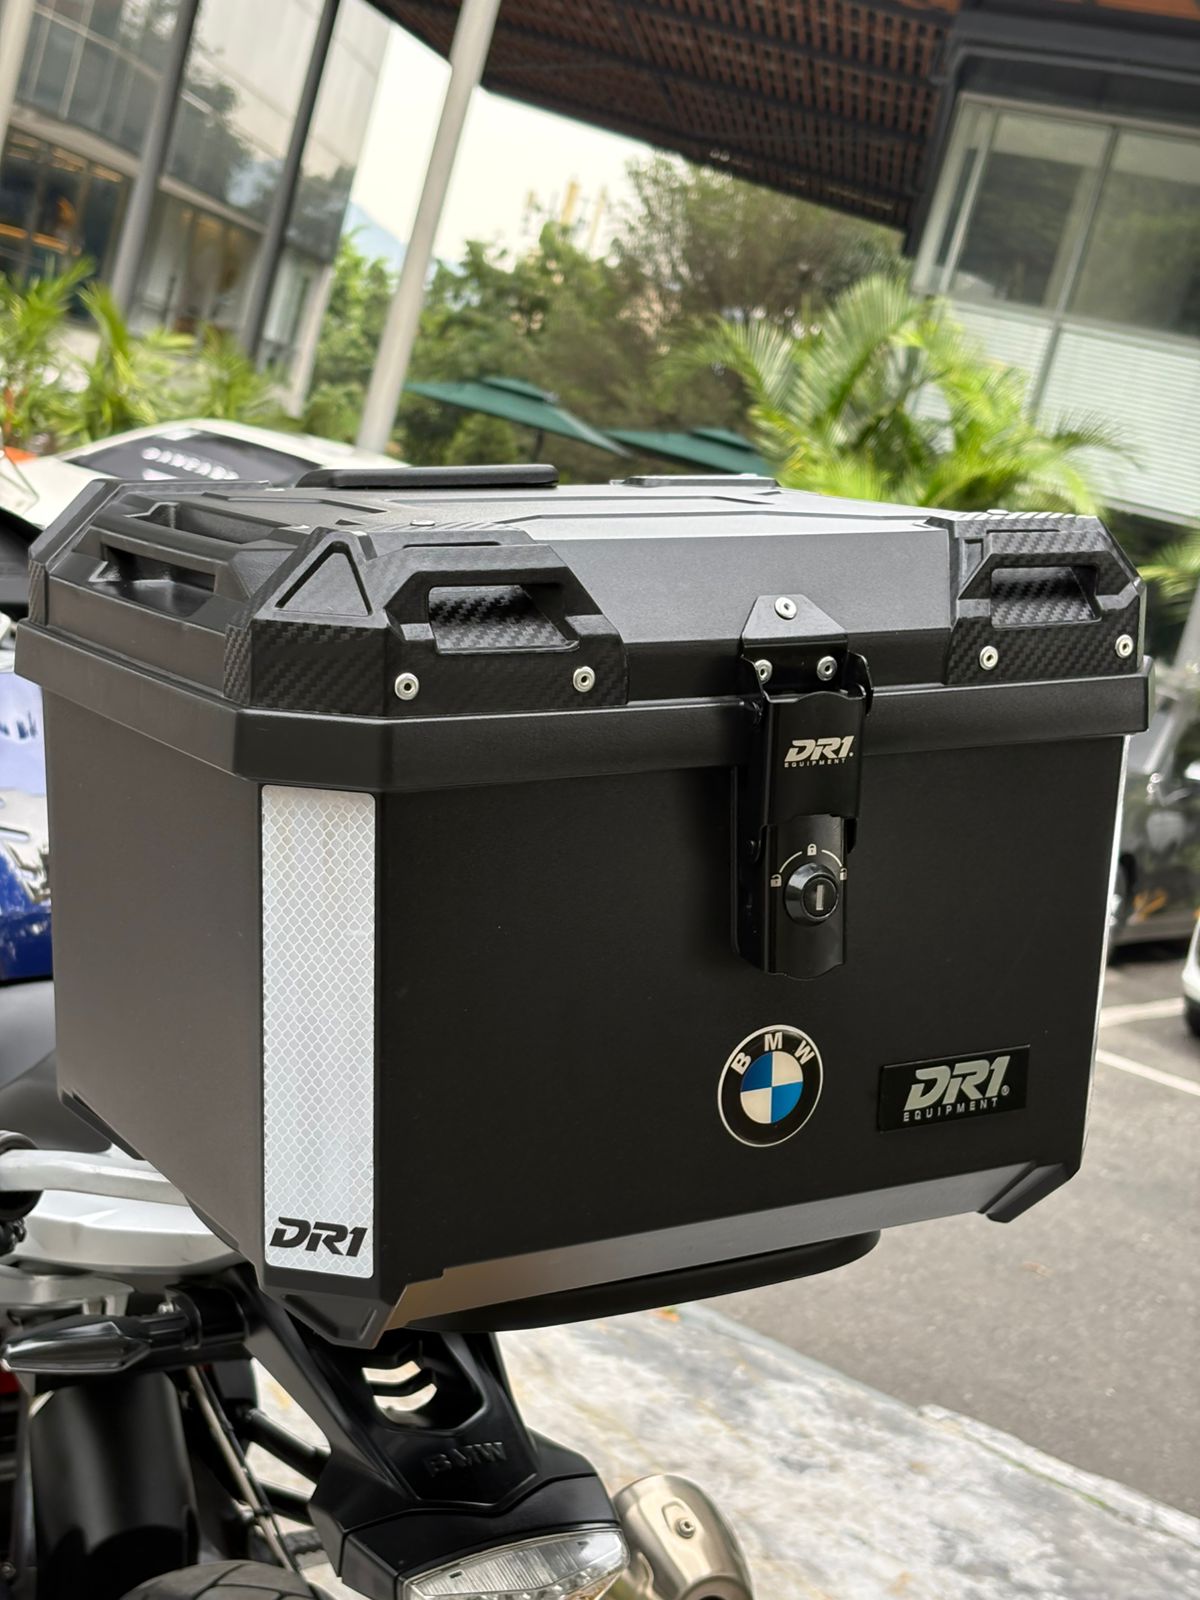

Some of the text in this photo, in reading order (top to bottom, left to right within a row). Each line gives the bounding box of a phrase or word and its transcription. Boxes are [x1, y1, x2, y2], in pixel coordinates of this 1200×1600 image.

[784, 735, 855, 762] DR1
[784, 757, 845, 768] EQUIPMENT
[730, 1031, 816, 1076] BMW
[903, 1097, 998, 1122] EQUIPMENT
[269, 1216, 368, 1257] DR1
[424, 1441, 507, 1478] BMW
